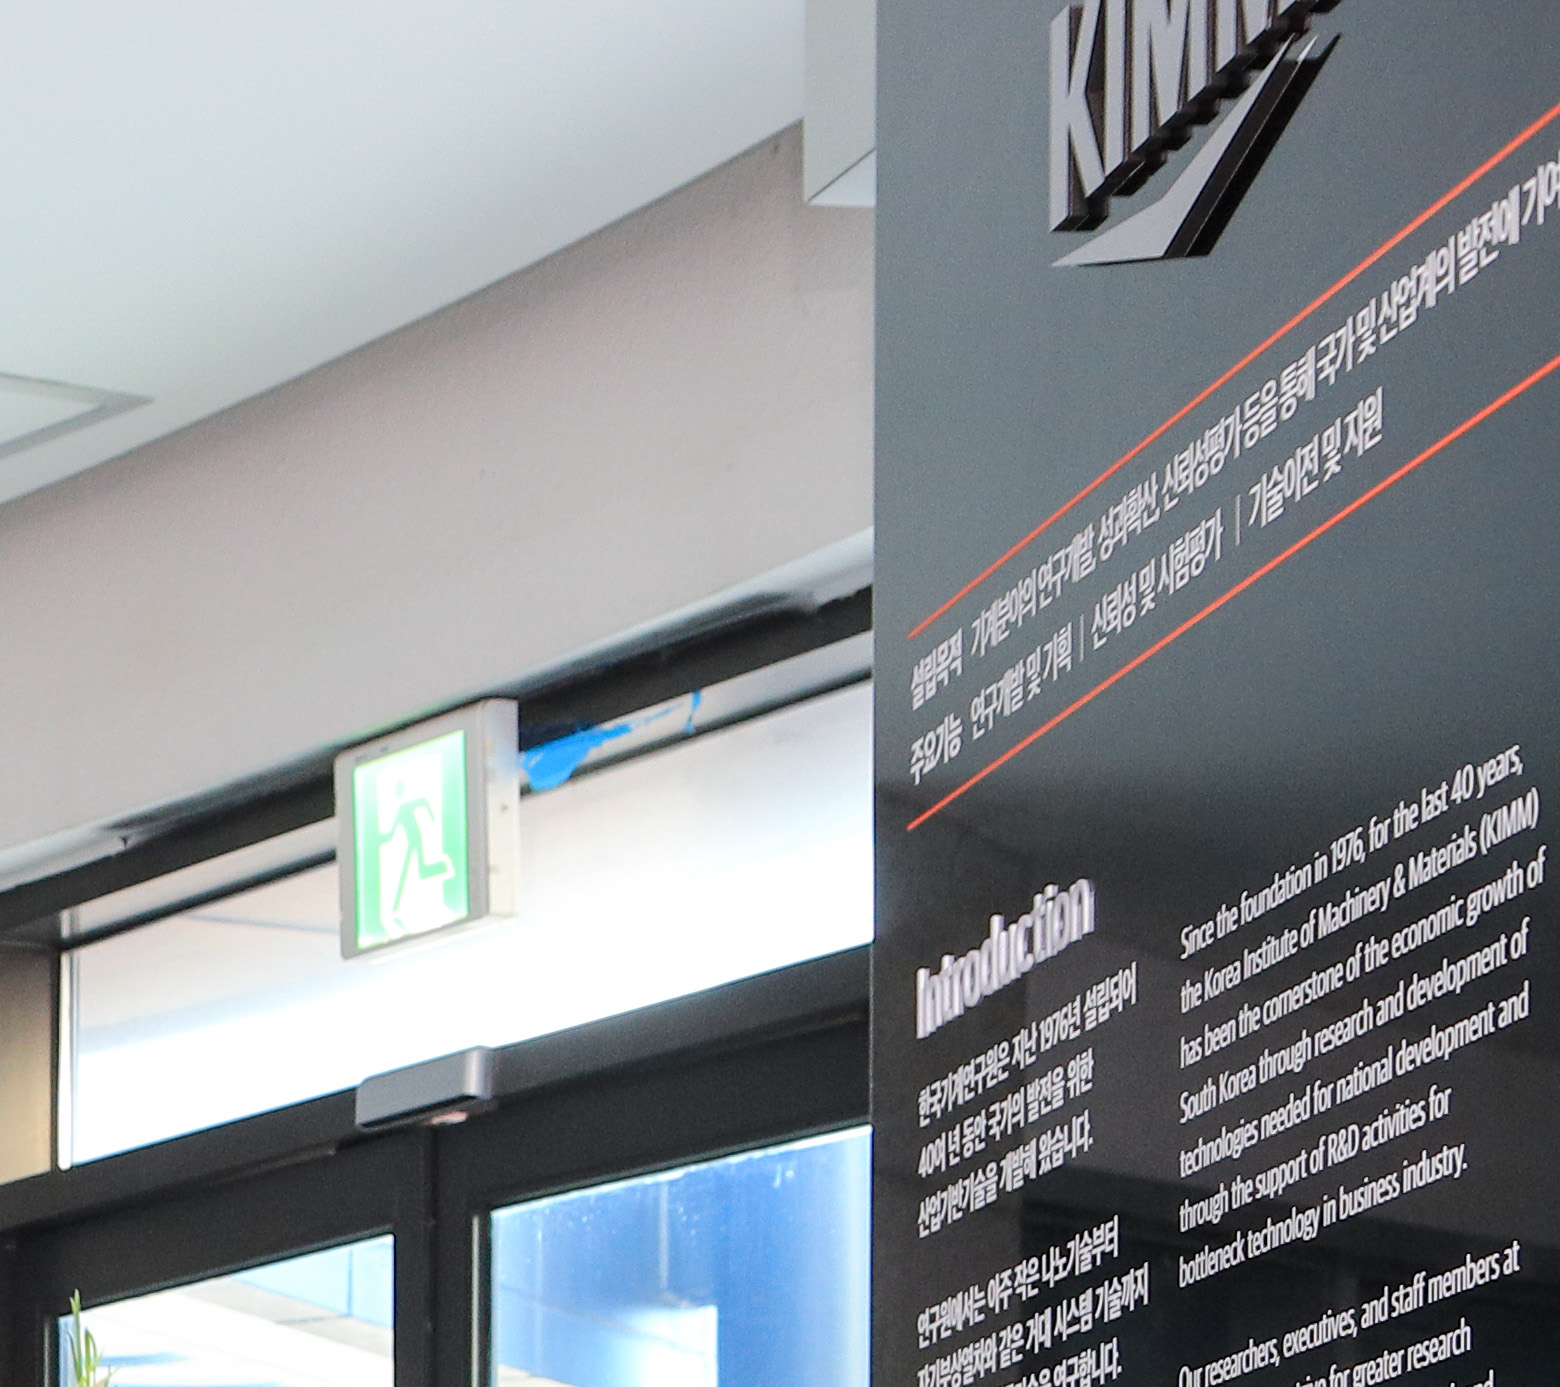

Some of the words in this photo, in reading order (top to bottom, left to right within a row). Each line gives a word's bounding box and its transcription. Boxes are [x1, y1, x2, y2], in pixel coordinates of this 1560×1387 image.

[910, 628, 963, 710] 설립목적
[970, 568, 1037, 656] 기계분야의
[1160, 405, 1244, 512] 신뢰성평가
[1241, 379, 1280, 449] 등을
[1277, 345, 1317, 421] 통해
[1315, 315, 1357, 385] 국가
[1355, 297, 1377, 364] 및
[1376, 235, 1456, 345] 산업계의
[1456, 185, 1521, 285] 발전에
[909, 713, 964, 786] 주요기능
[970, 659, 1026, 740] 연구개발
[1025, 645, 1042, 701] 및
[1041, 622, 1073, 681] 기획
[1090, 572, 1137, 650] 신뢰성
[1138, 557, 1156, 617] 및
[1156, 508, 1224, 595] 시험평가
[1247, 434, 1320, 527] 기술이전
[1320, 416, 1342, 483] 및
[1342, 386, 1383, 457] 지원
[1179, 920, 1215, 960] Since
[1215, 903, 1239, 939] the
[1239, 863, 1313, 926] foundation
[1313, 851, 1329, 884] in
[1329, 826, 1367, 874] 1976,
[1367, 815, 1392, 853] for
[1392, 800, 1420, 839] the
[1420, 780, 1450, 824] last
[1449, 763, 1475, 805] 40
[1475, 744, 1524, 799] years,
[1179, 979, 1203, 1014] the
[1203, 960, 1242, 1002] Korea
[1242, 928, 1299, 980] Institute
[1299, 908, 1318, 949] of
[1317, 877, 1392, 940] Machinery
[1392, 863, 1407, 899] &
[1407, 824, 1478, 890] Materials
[1479, 787, 1540, 855] (KIMM)
[916, 879, 1095, 1038] Introduction
[917, 1041, 1011, 1128] 한국기계연구원은
[1010, 1021, 1039, 1070] 지난
[1038, 994, 1082, 1053] 1976년
[1082, 961, 1137, 1031] 설립되어
[998, 1322, 1025, 1369] 같은
[1024, 1306, 1053, 1355] 거대
[1053, 1287, 1094, 1342] 시스템
[1094, 1261, 1149, 1323] 기술까지
[1204, 1338, 1281, 1387] researchers,
[1282, 1308, 1359, 1358] executives,
[1360, 1285, 1389, 1329] and
[1390, 1270, 1427, 1318] staff
[1427, 1252, 1501, 1304] members
[1502, 1240, 1521, 1276] at
